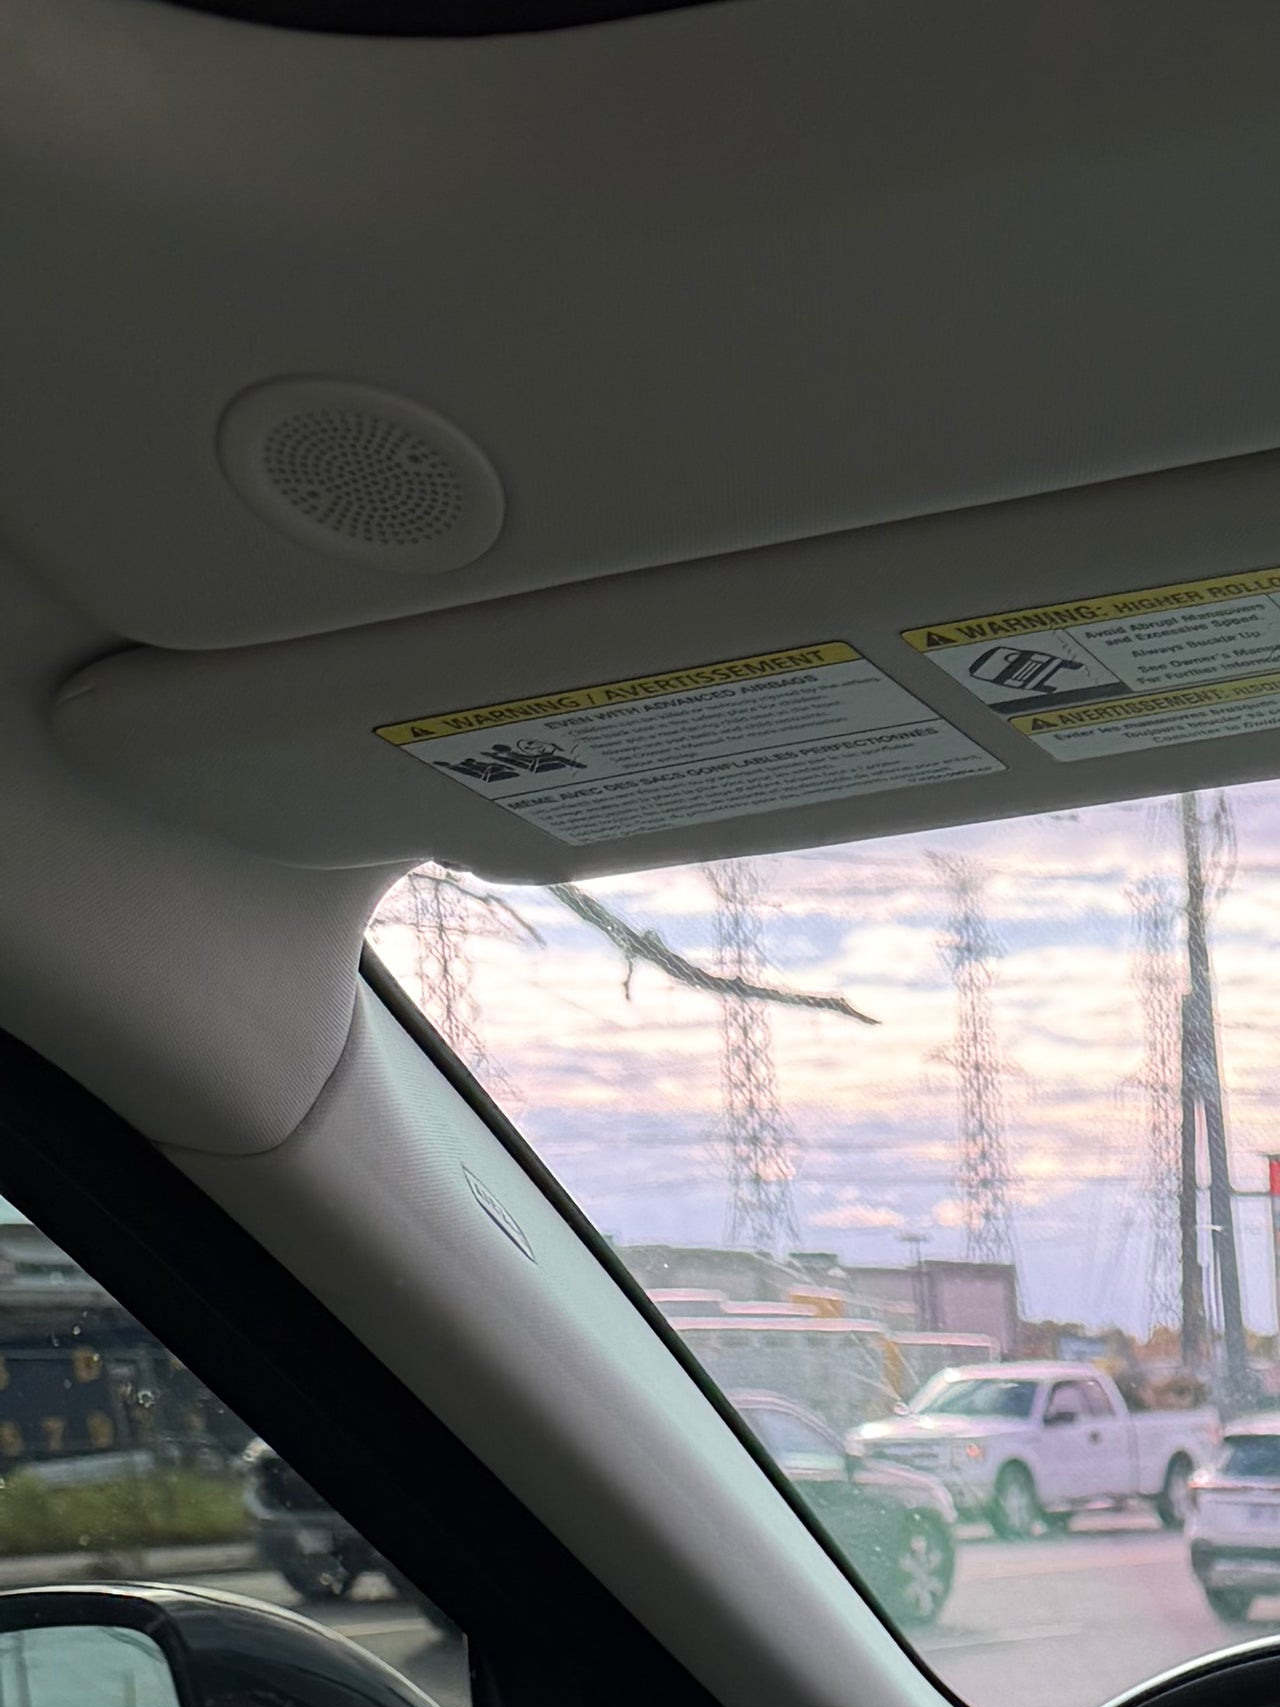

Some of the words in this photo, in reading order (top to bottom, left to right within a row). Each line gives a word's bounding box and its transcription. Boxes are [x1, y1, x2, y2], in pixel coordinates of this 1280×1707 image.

[956, 605, 1108, 640] WARNING:
[1115, 590, 1202, 616] HIGHER
[1085, 625, 1127, 640] Avoid
[1129, 616, 1178, 634] Abrupt
[1104, 635, 1133, 647] and
[1131, 642, 1184, 660] Always
[443, 696, 578, 730] WARNING
[597, 649, 825, 701] AVERTISSEMENT
[544, 716, 593, 731] EVEN
[596, 705, 639, 722] WITH
[643, 688, 736, 713] ADVANCED
[740, 674, 819, 694] AIRBAGS
[1057, 686, 1230, 726] AVERTISSEMENT:
